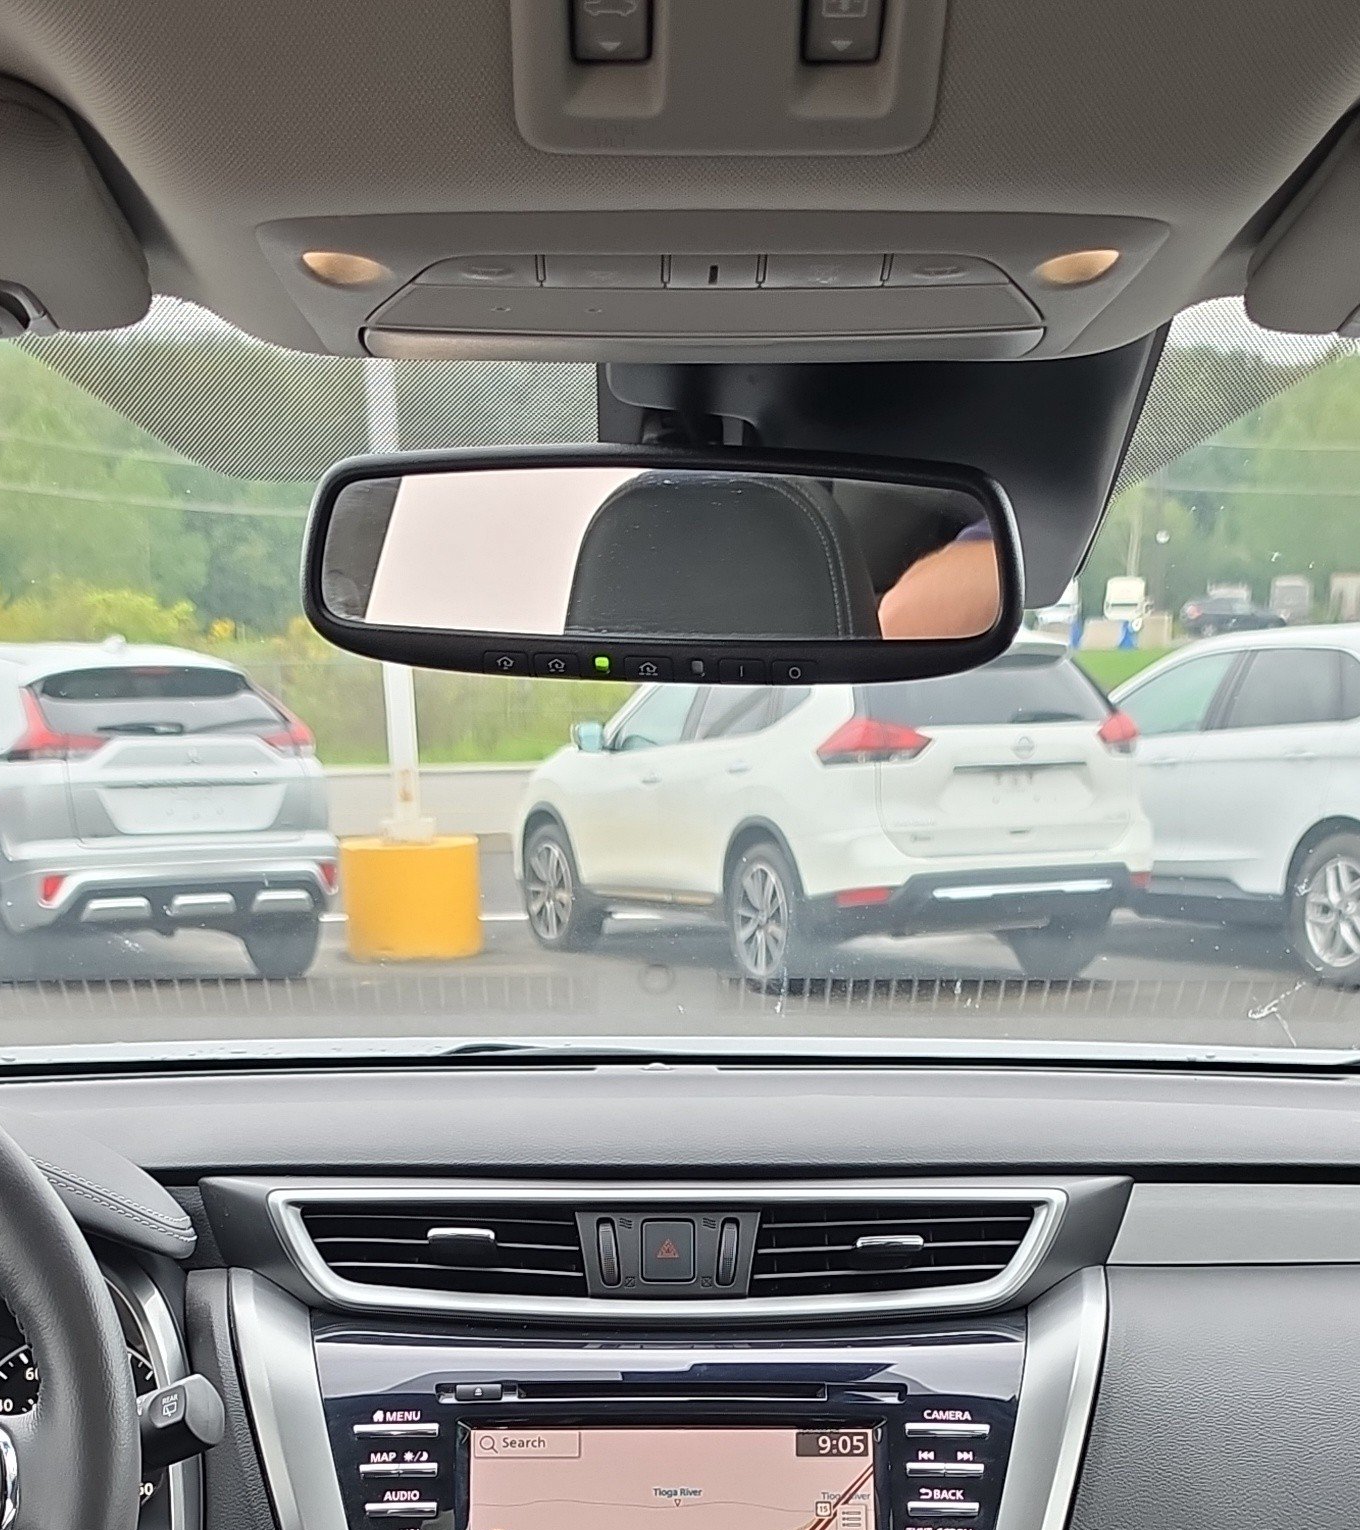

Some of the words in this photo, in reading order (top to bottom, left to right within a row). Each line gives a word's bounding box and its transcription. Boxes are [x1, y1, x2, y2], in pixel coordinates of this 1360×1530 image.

[162, 1394, 178, 1405] REAR
[386, 1410, 420, 1421] MENU
[923, 1410, 971, 1421] CAMERA
[502, 1437, 546, 1448] Search
[818, 1435, 865, 1454] 9:05
[370, 1452, 397, 1462] MAP
[383, 1490, 420, 1501] AUDIO
[653, 1488, 678, 1498] Tioga
[680, 1488, 702, 1497] River
[934, 1489, 963, 1500] BACK
[819, 1505, 828, 1513] 15
